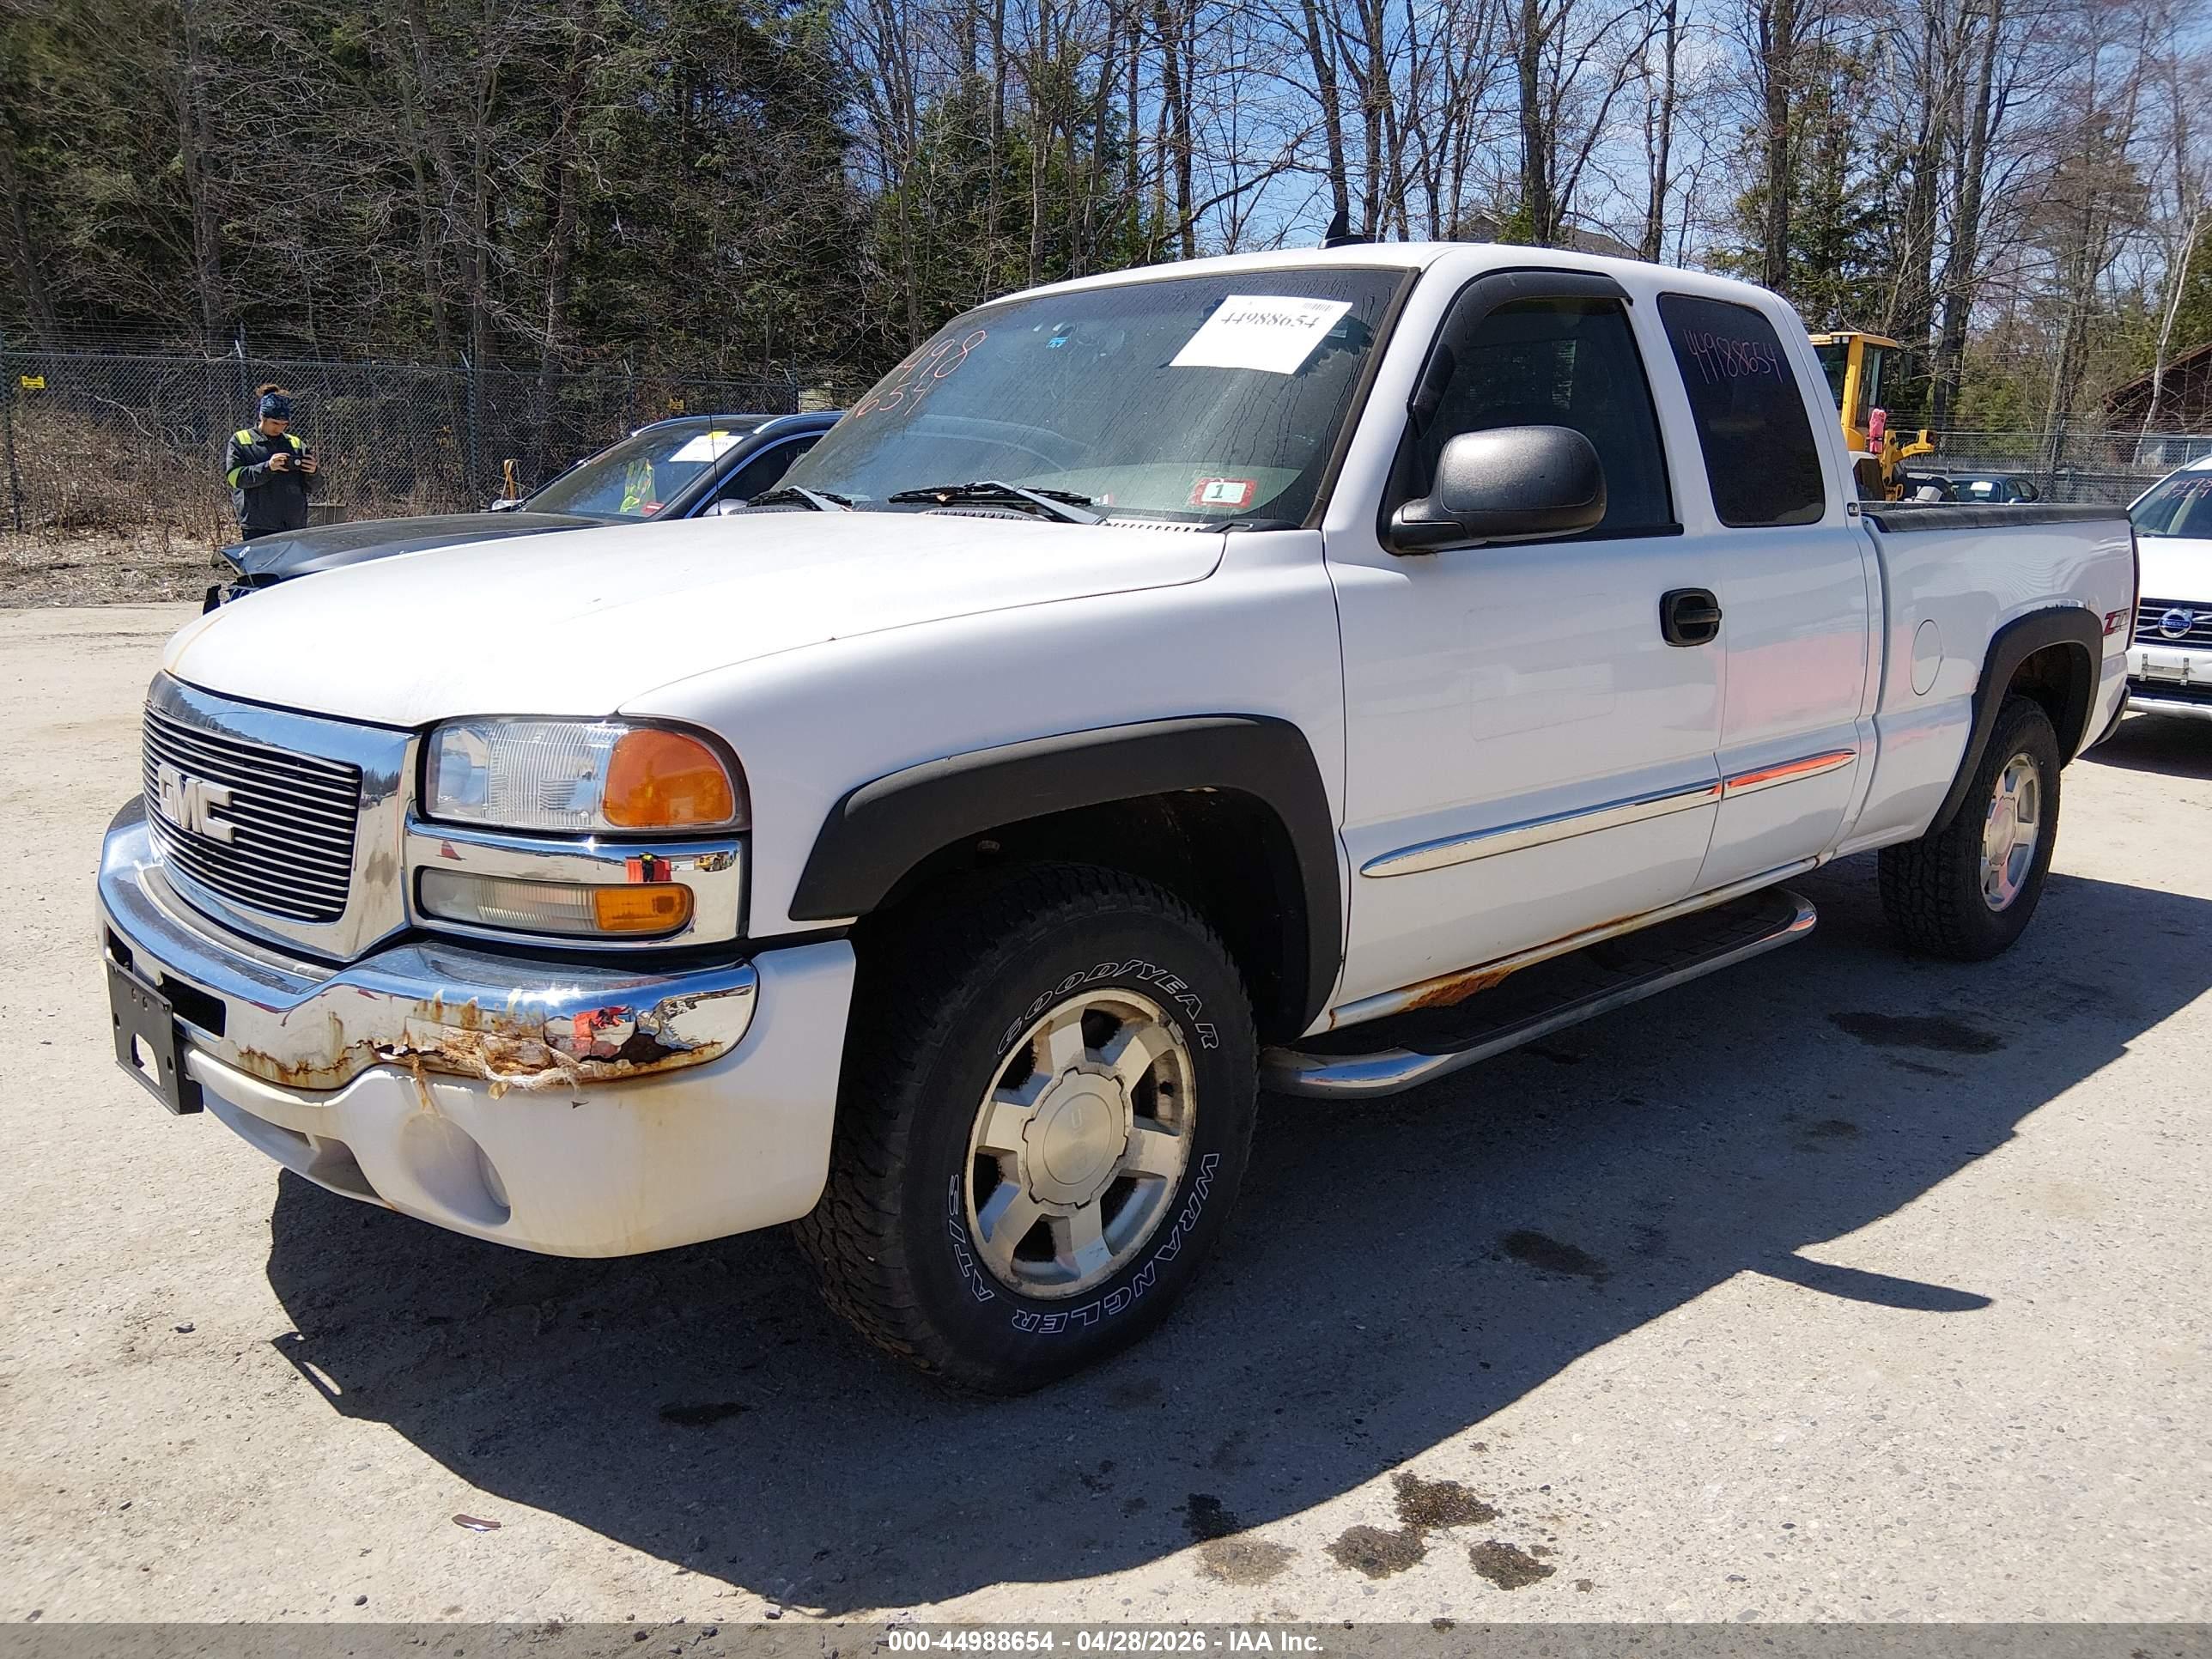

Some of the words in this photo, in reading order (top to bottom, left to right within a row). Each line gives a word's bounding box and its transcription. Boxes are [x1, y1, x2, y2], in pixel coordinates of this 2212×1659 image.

[1220, 312, 1321, 329] 44988654
[1683, 329, 1784, 385] 44988654
[2161, 619, 2189, 628] VOLVO
[158, 763, 234, 844] GMC
[996, 959, 1219, 1055] GOODYEAR
[1012, 1153, 1220, 1334] WRANGLER
